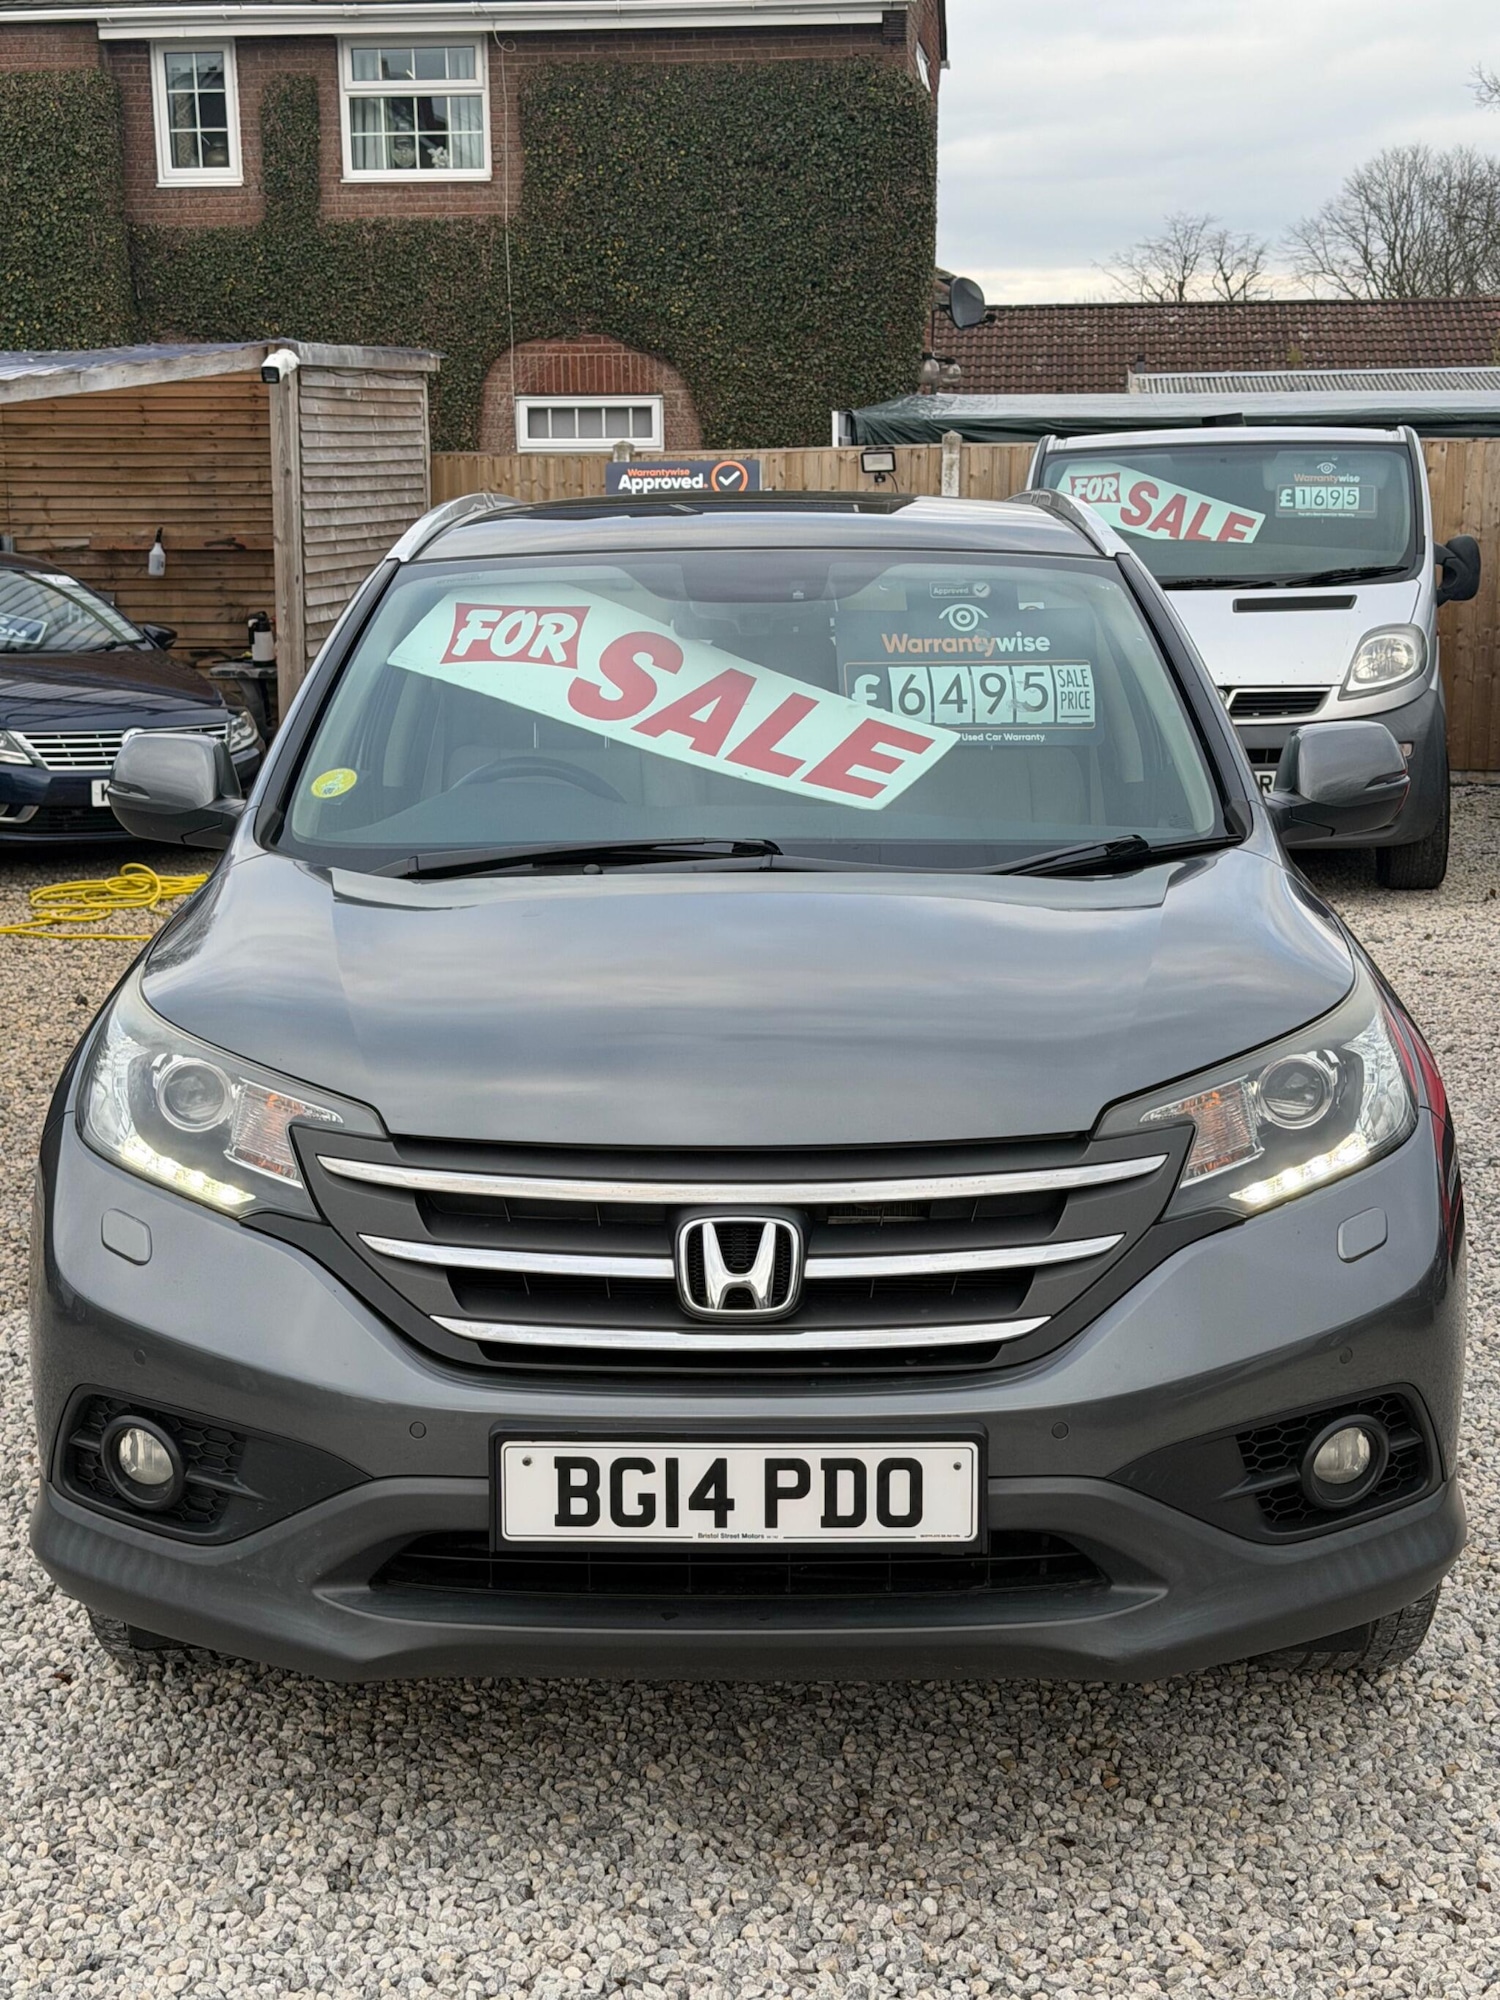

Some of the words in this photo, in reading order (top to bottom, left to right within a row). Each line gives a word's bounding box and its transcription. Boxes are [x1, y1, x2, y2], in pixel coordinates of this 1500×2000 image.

[627, 467, 690, 477] Warrantywise
[1293, 473, 1361, 484] Warrantywise
[618, 473, 709, 494] Approved.
[1280, 488, 1358, 508] £1695
[1072, 476, 1118, 503] FOR
[1120, 480, 1257, 542] SALE
[881, 631, 1051, 657] Warrantywise
[1057, 669, 1090, 688] SALE
[450, 608, 580, 665] FOR
[568, 630, 937, 800] SALE
[852, 671, 1050, 717] £6495
[1059, 691, 1091, 710] PRICE
[961, 733, 984, 742] Used
[985, 733, 1002, 742] Car
[554, 1456, 735, 1528] BG14
[764, 1457, 923, 1529] PDO
